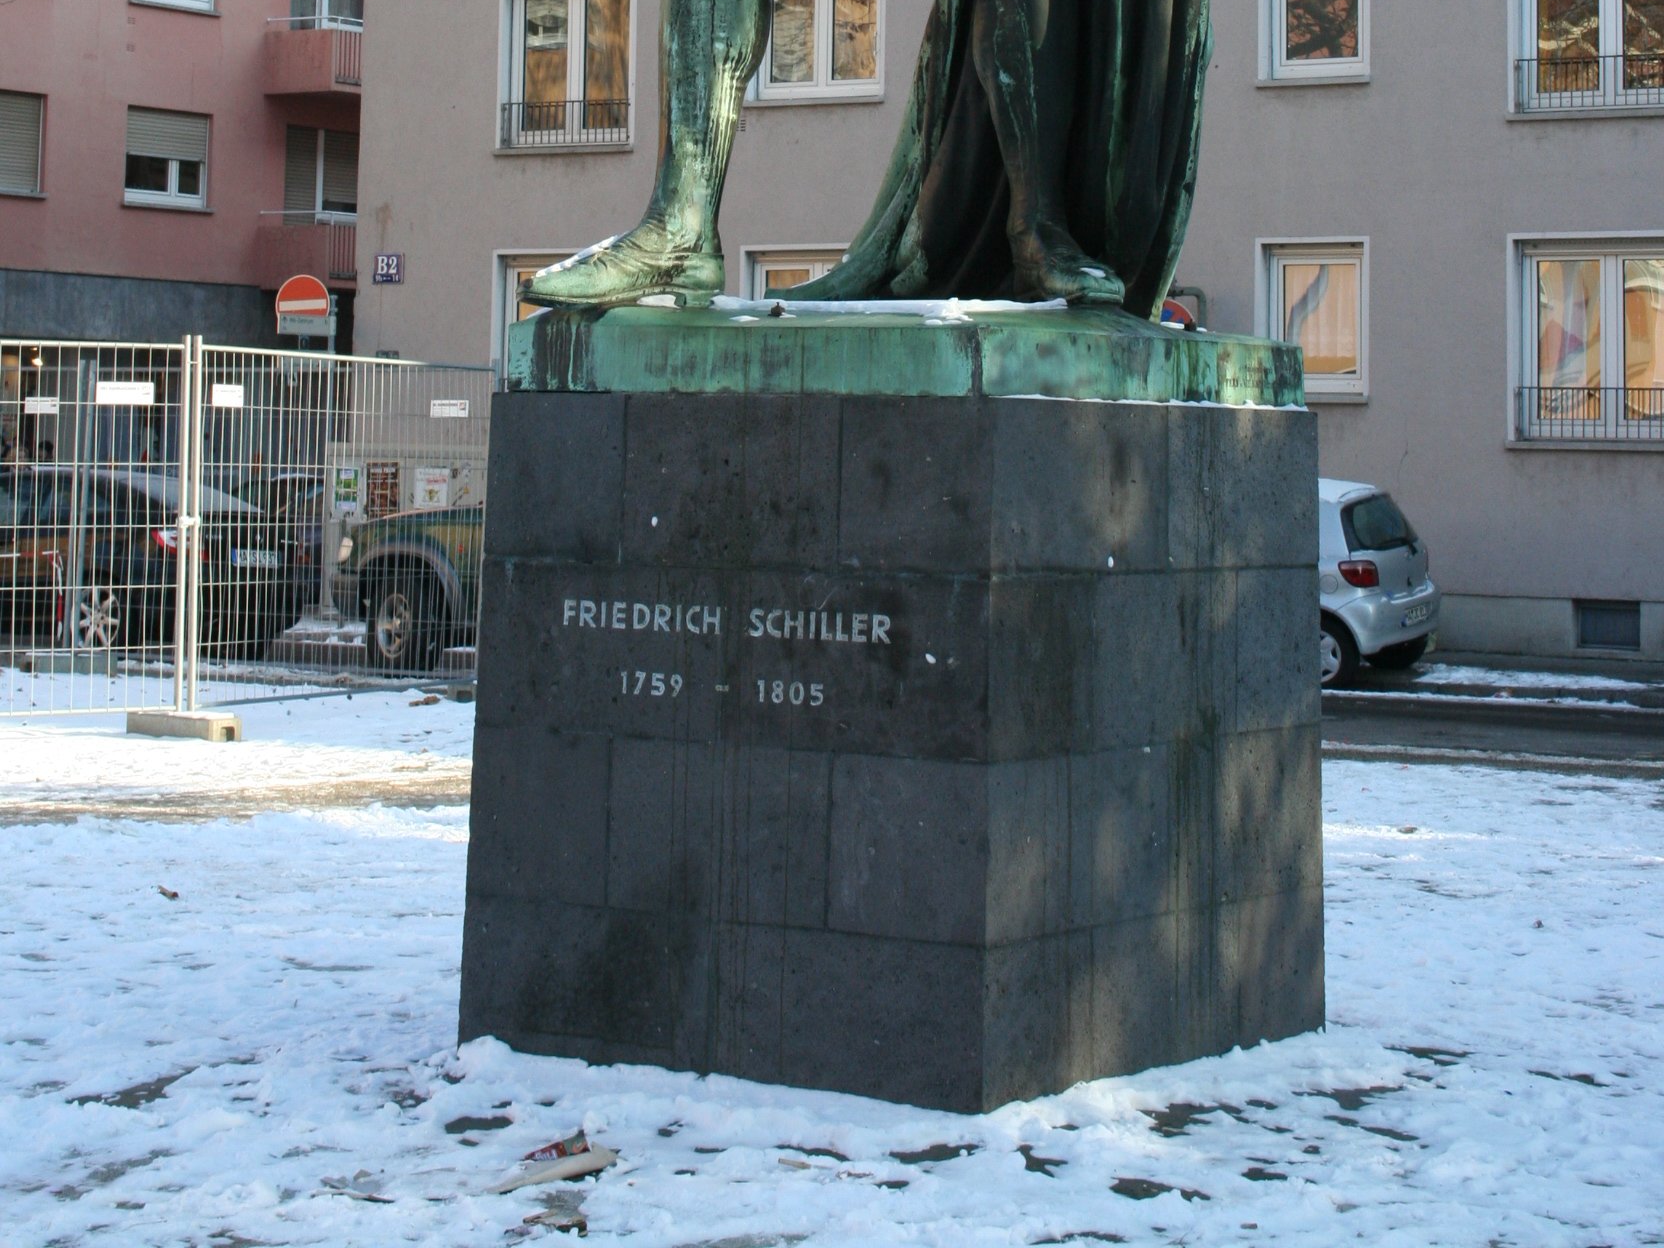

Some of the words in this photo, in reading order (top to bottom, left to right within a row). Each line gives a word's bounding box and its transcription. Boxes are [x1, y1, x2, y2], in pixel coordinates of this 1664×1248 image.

[562, 598, 721, 635] FRIEDRICH
[748, 607, 892, 644] SCHILLER
[620, 670, 683, 697] 1759
[757, 679, 824, 706] 1805
